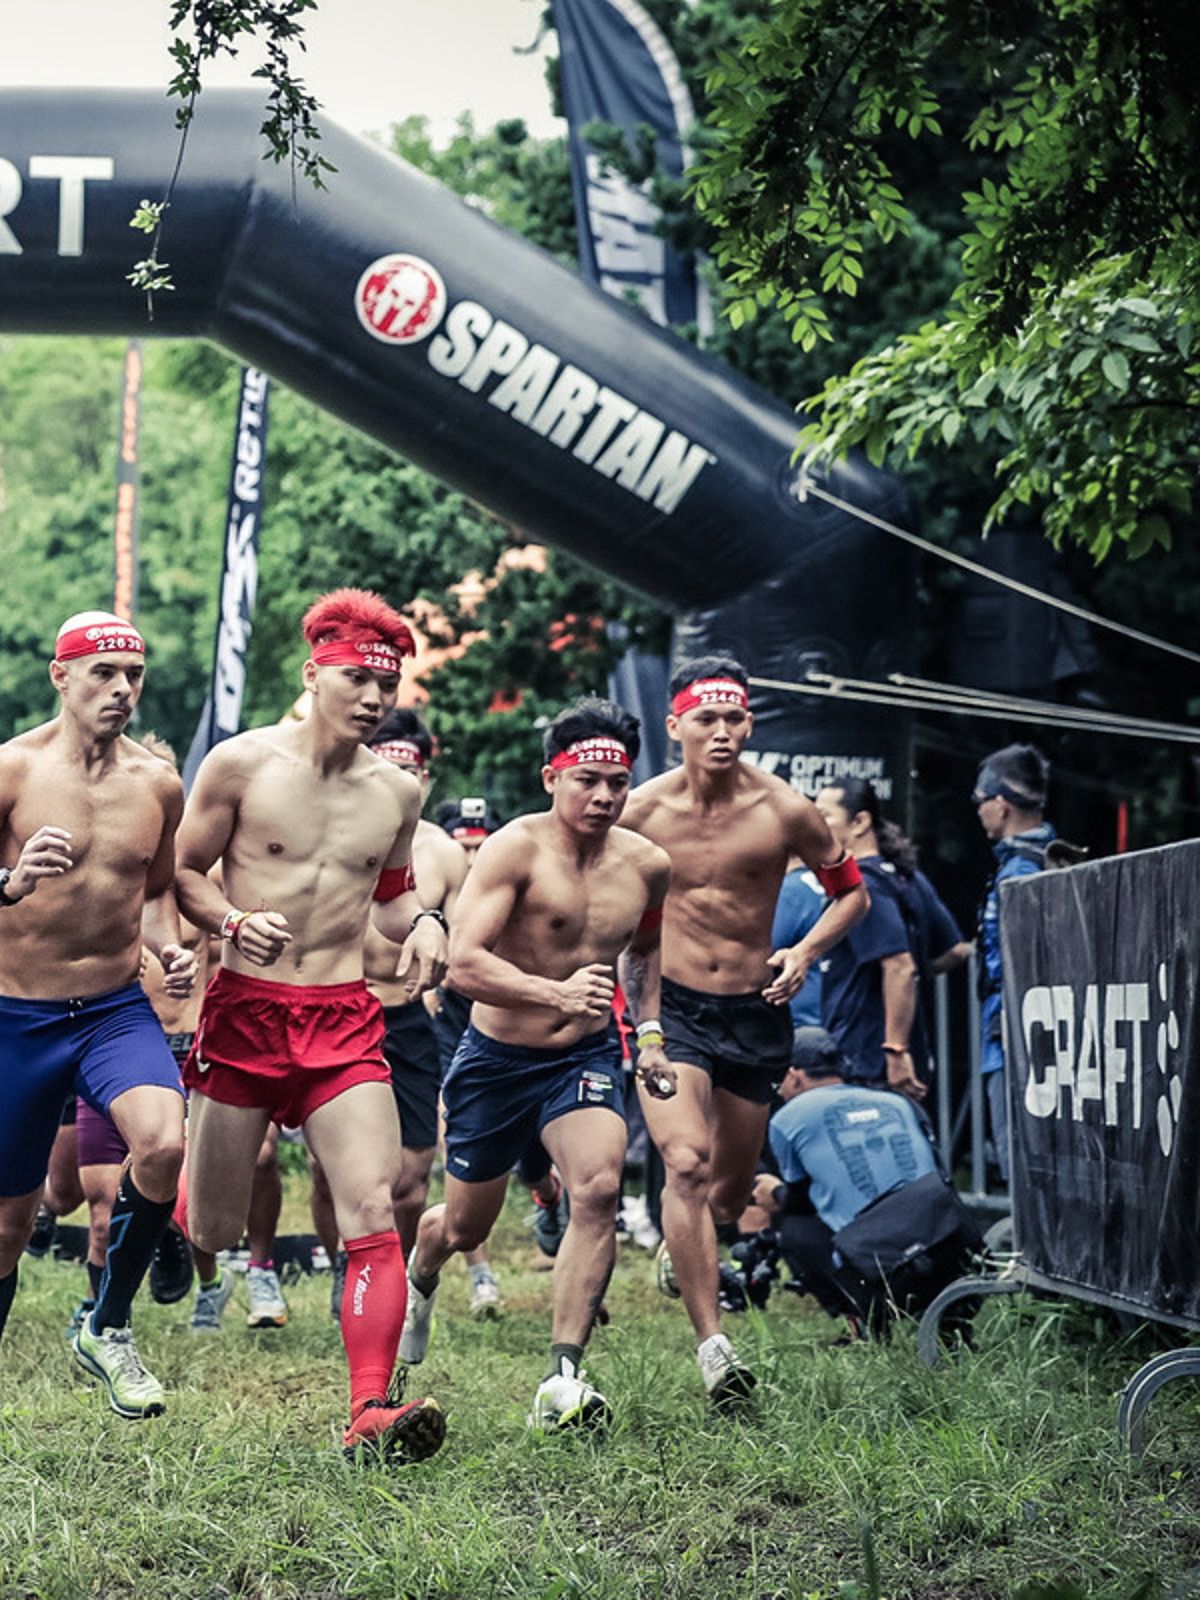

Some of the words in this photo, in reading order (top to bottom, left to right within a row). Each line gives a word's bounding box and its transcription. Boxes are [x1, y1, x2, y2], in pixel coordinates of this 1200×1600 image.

[428, 300, 711, 514] SPARTAN
[789, 754, 885, 779] OPTIMUM
[1022, 983, 1150, 1129] CRAFT
